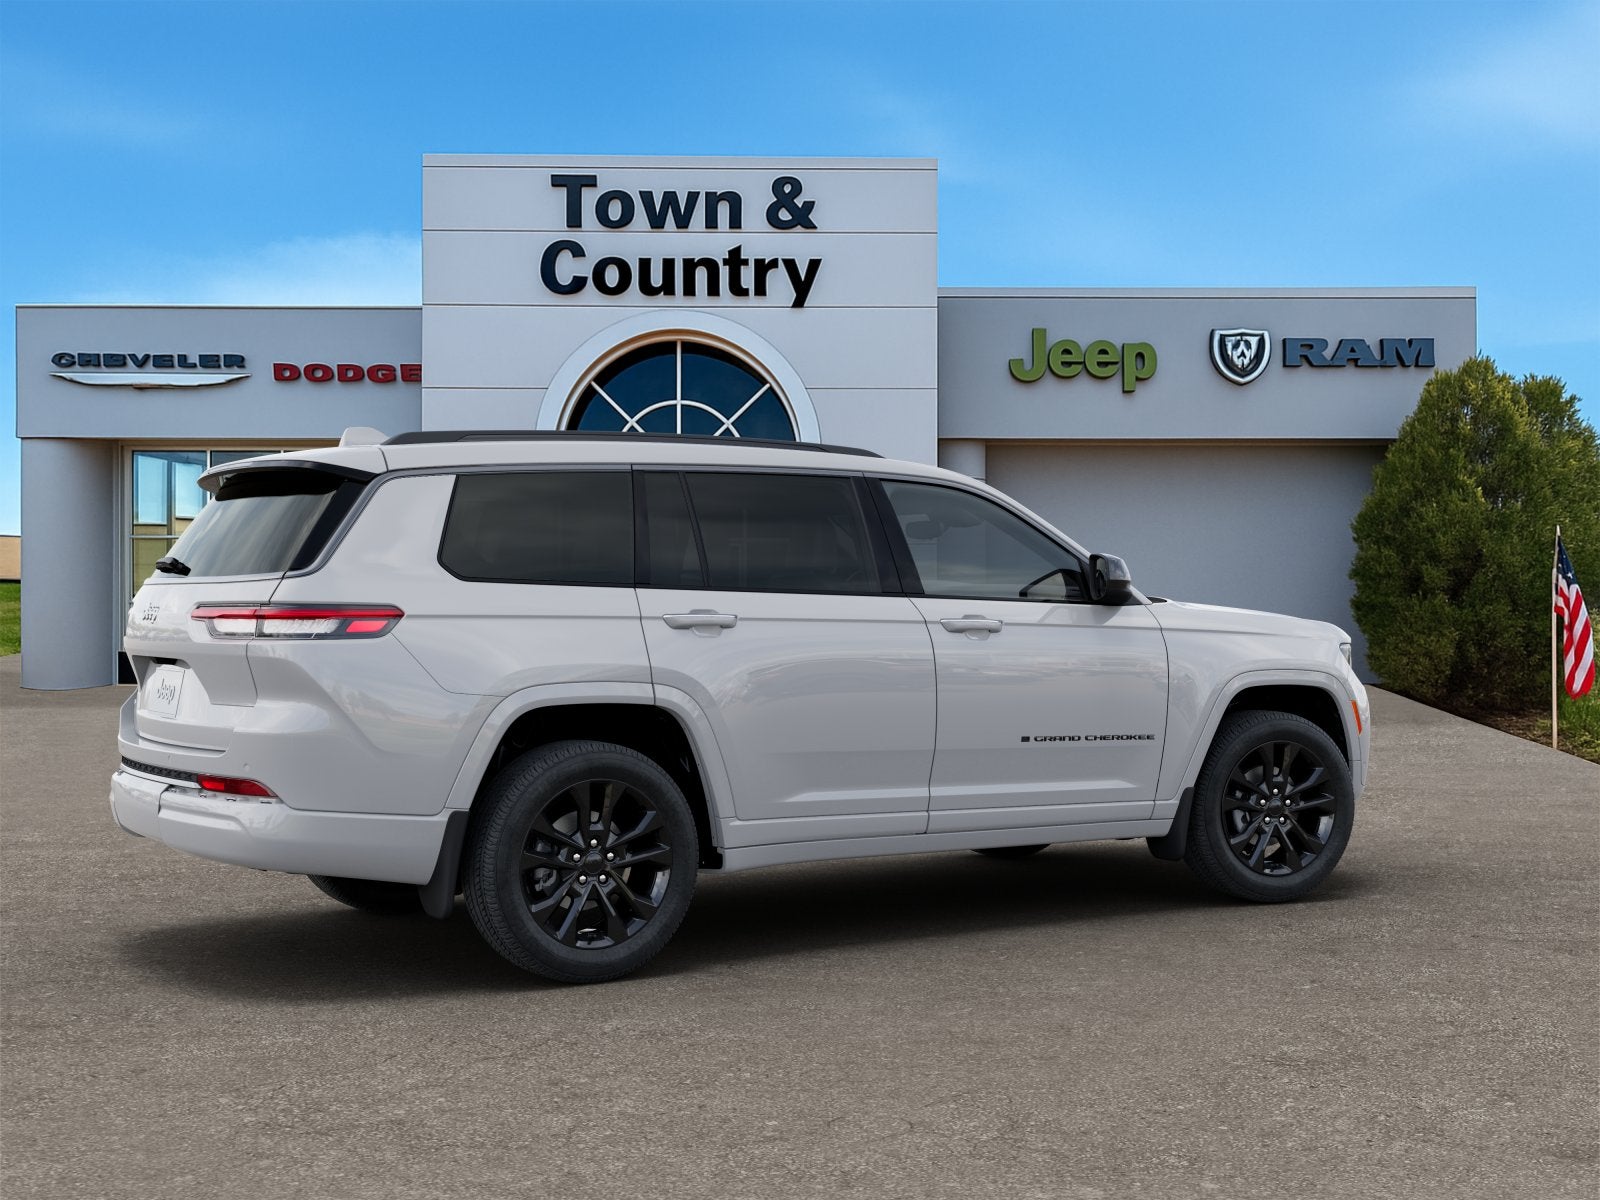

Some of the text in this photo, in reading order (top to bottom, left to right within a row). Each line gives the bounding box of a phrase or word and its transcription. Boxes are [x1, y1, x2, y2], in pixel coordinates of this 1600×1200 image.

[550, 173, 818, 230] Town &
[539, 239, 822, 309] Country
[272, 362, 422, 384] DODGE
[1008, 327, 1157, 393] Jeep
[1282, 337, 1436, 368] RAM
